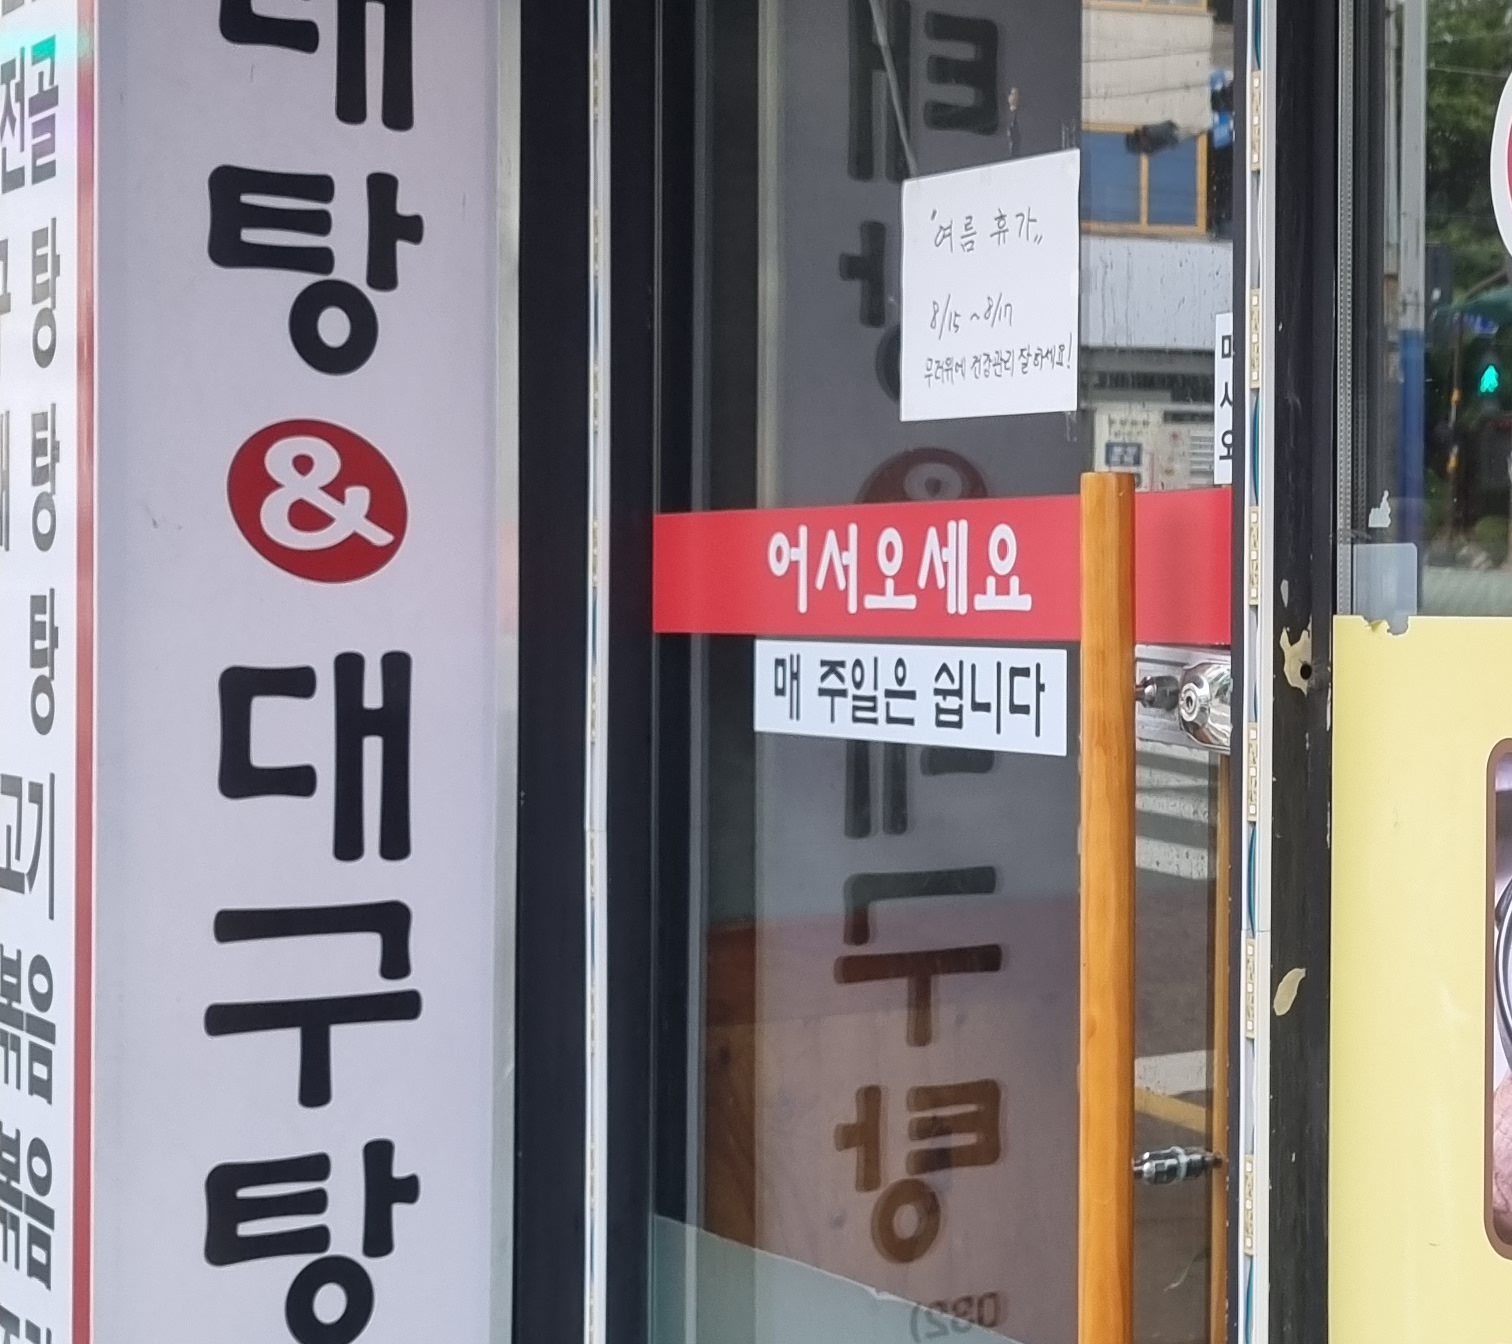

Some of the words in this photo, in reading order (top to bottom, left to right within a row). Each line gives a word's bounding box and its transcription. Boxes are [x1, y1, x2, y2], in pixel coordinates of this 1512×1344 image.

[258, 435, 394, 551] &
[768, 519, 1033, 616] 어서오세요
[773, 652, 802, 721] 매
[818, 656, 918, 726] 주일은
[932, 661, 1046, 738] 쉽니다
